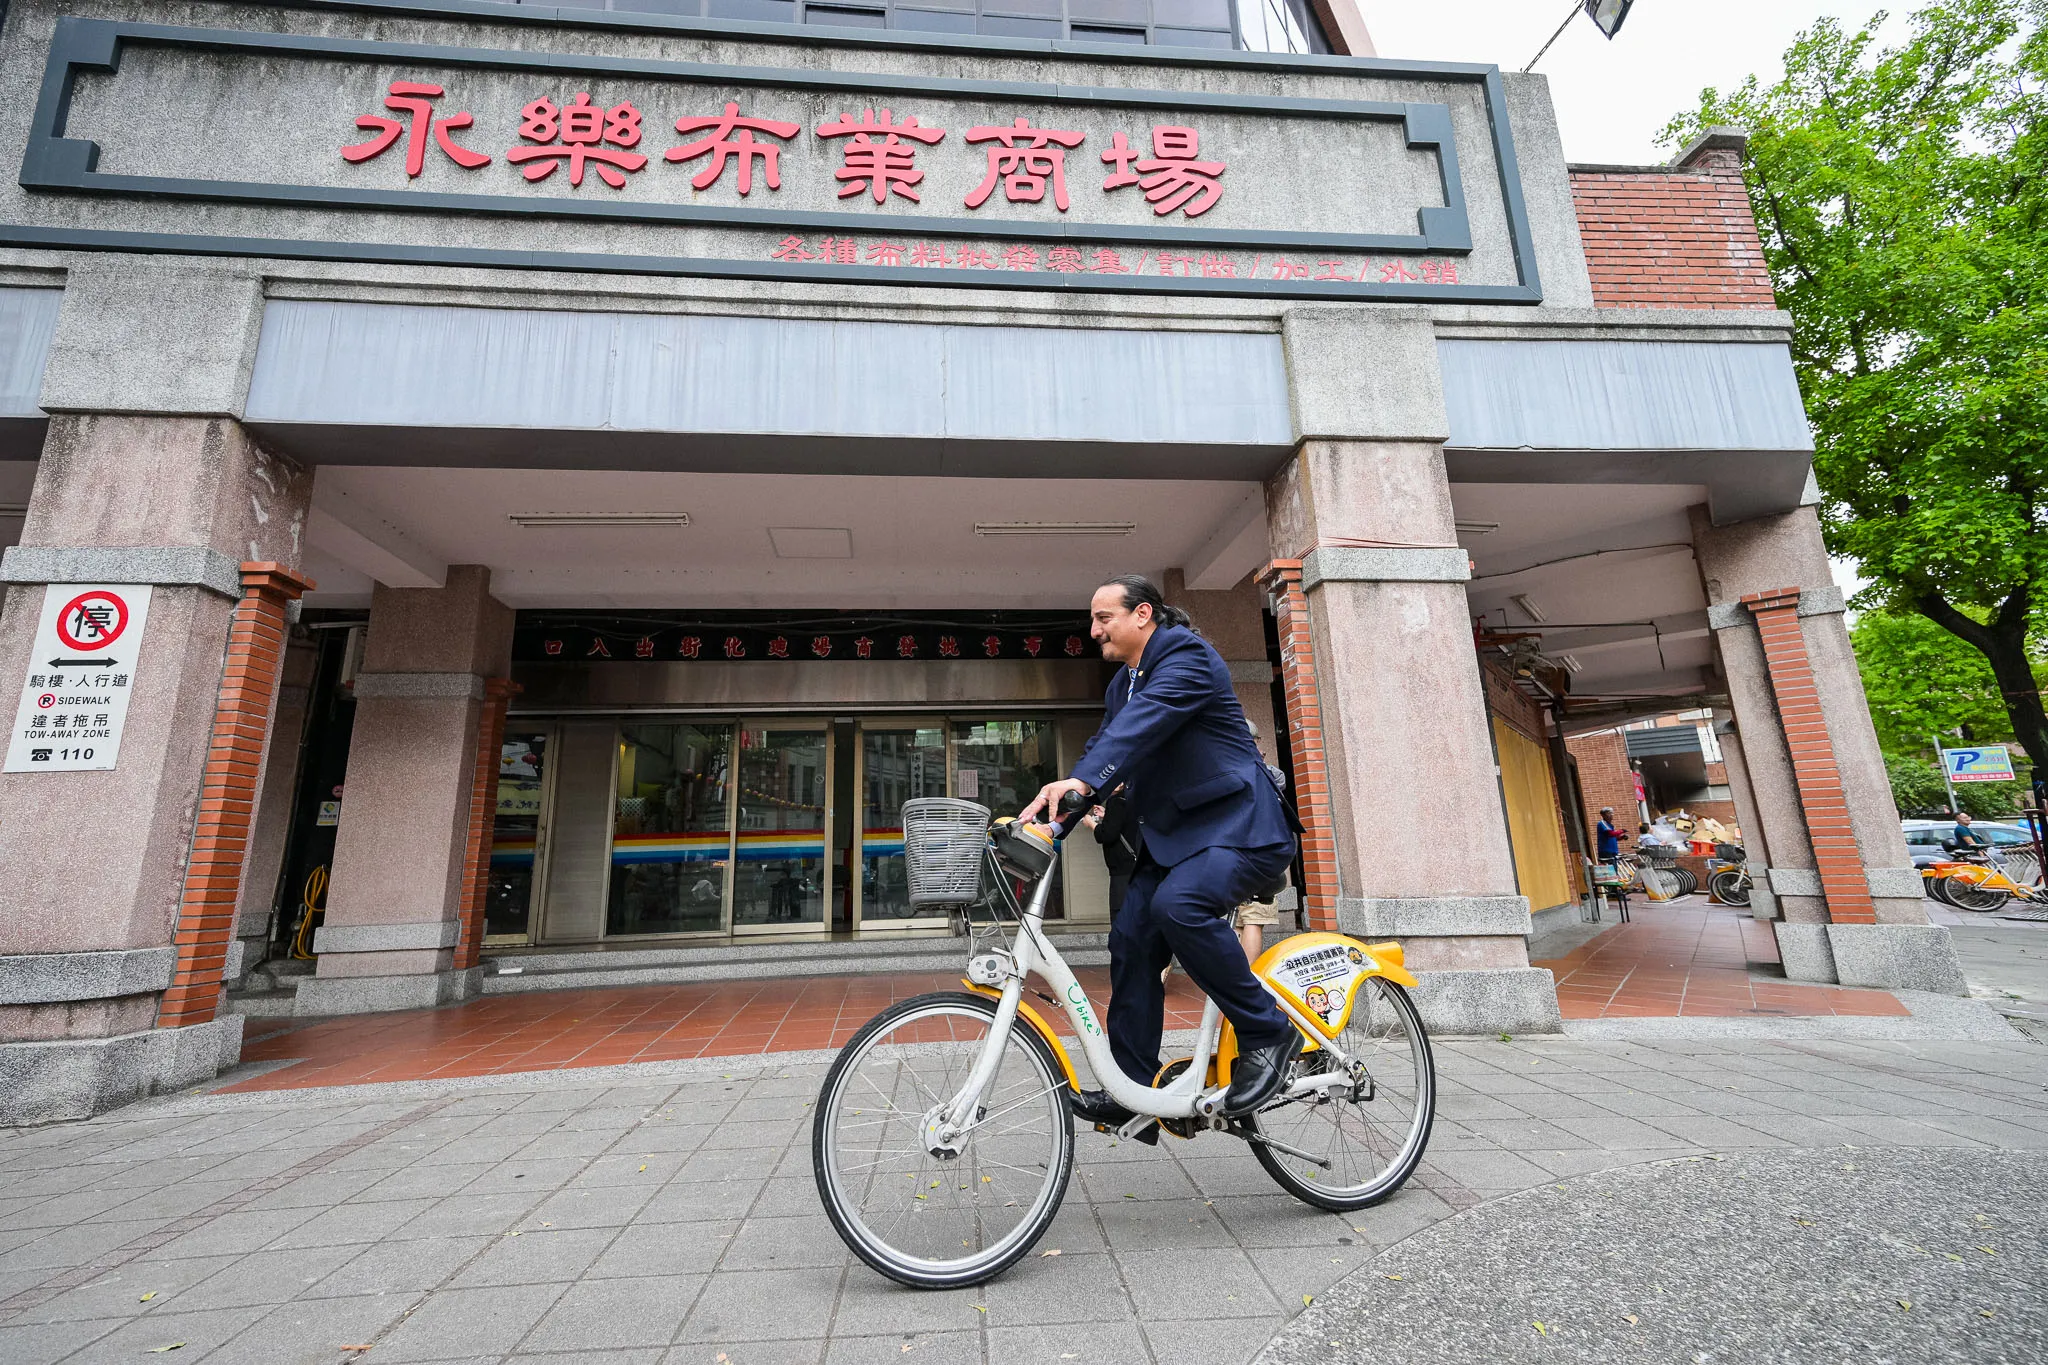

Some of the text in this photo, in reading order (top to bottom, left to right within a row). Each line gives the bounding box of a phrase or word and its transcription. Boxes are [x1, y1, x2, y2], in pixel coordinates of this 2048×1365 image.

[340, 81, 1227, 219] 永樂布業商場
[74, 605, 114, 638] 停
[57, 696, 111, 705] SIDEWALK
[31, 713, 108, 728] 違者拖吊
[24, 729, 111, 739] TOW-AWAY ZONE
[60, 748, 94, 760] 110
[1950, 751, 1980, 771] P
